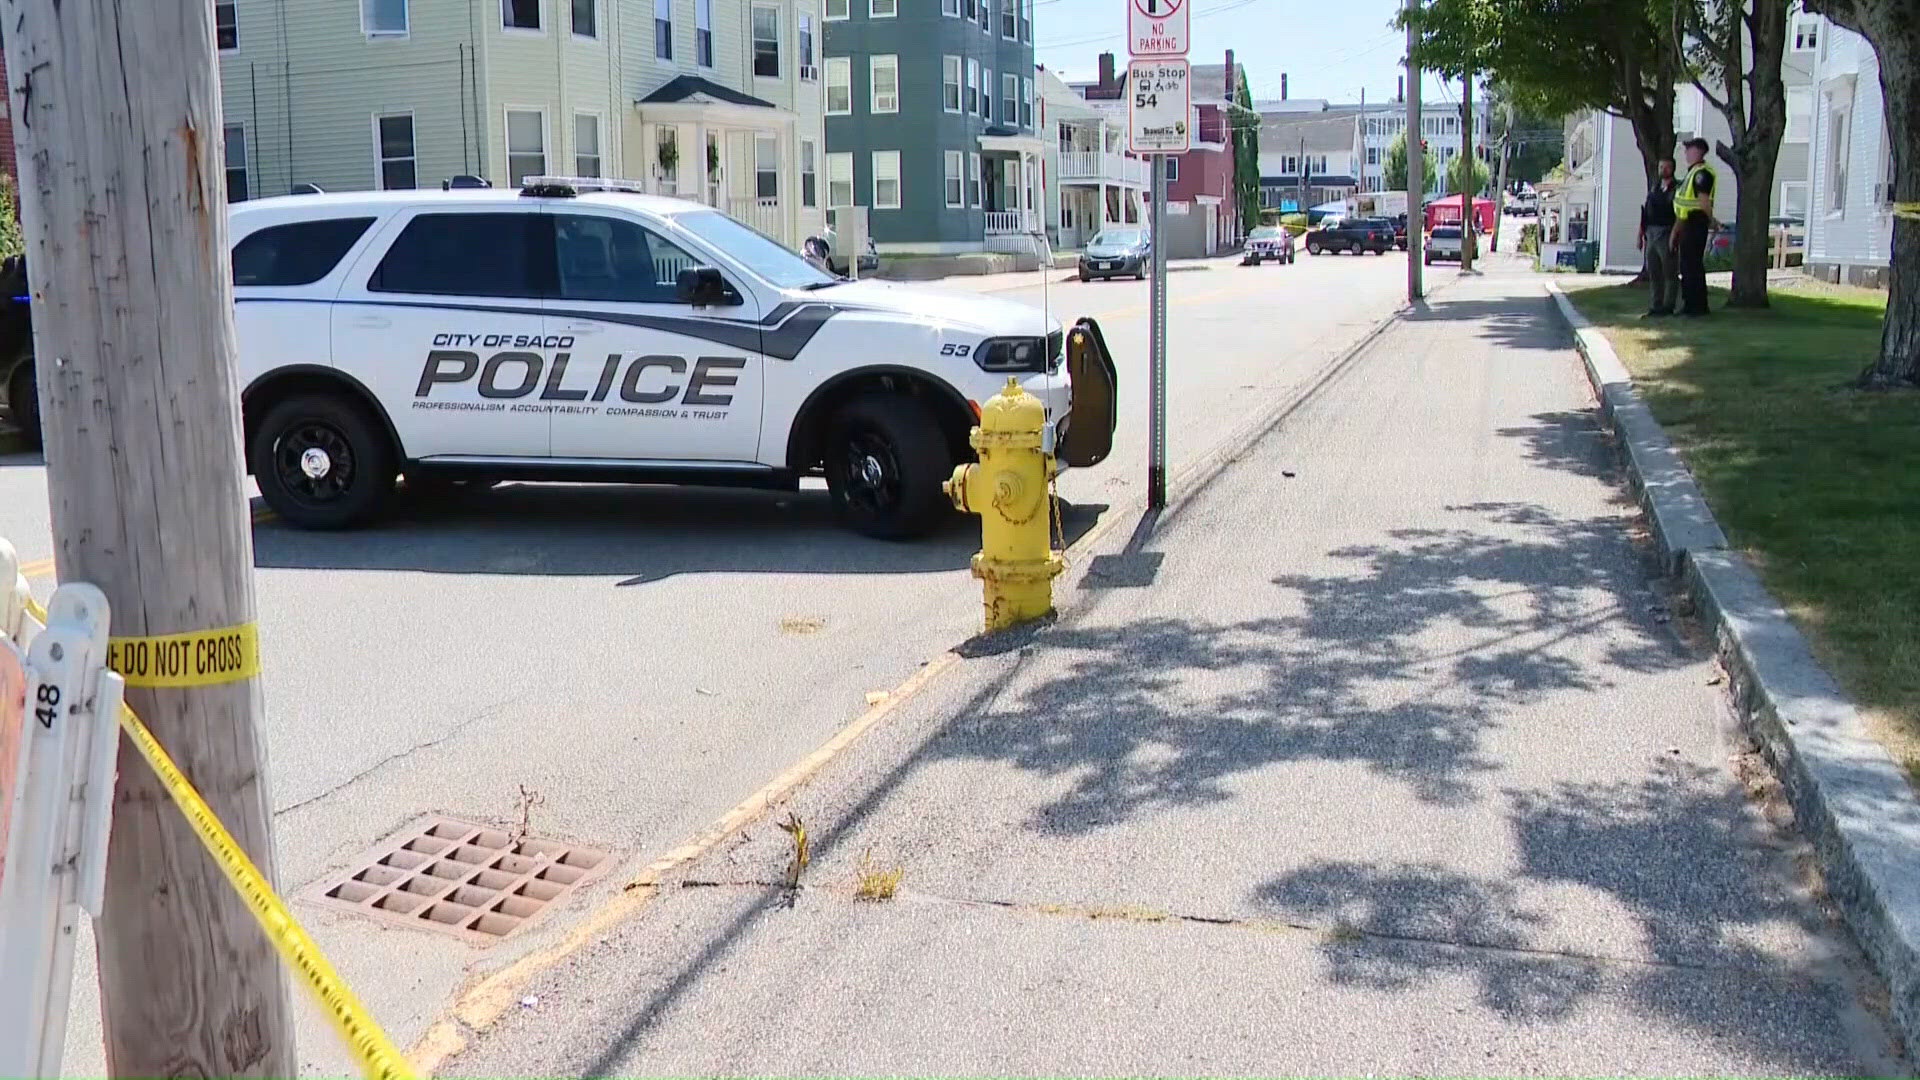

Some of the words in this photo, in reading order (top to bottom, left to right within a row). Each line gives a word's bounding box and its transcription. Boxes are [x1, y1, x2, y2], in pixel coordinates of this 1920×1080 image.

[1152, 22, 1164, 35] NO
[1139, 37, 1177, 50] PARKING
[1132, 69, 1154, 78] Bus
[1158, 68, 1186, 79] Stop
[1136, 93, 1157, 108] 54
[432, 333, 481, 347] CITY
[483, 334, 513, 348] OF
[513, 335, 575, 349] SACO
[940, 343, 971, 357] 53
[415, 350, 747, 406] POLICE
[412, 402, 505, 411] PROFESSIONALISM
[510, 403, 598, 414] ACCOUNTABILITY
[606, 407, 678, 418] COMPASSION
[681, 410, 689, 418] &
[693, 410, 728, 419] TRUST
[124, 642, 148, 676] DO
[155, 640, 191, 676] NOT
[196, 634, 242, 674] CROSS
[35, 683, 60, 729] 48
